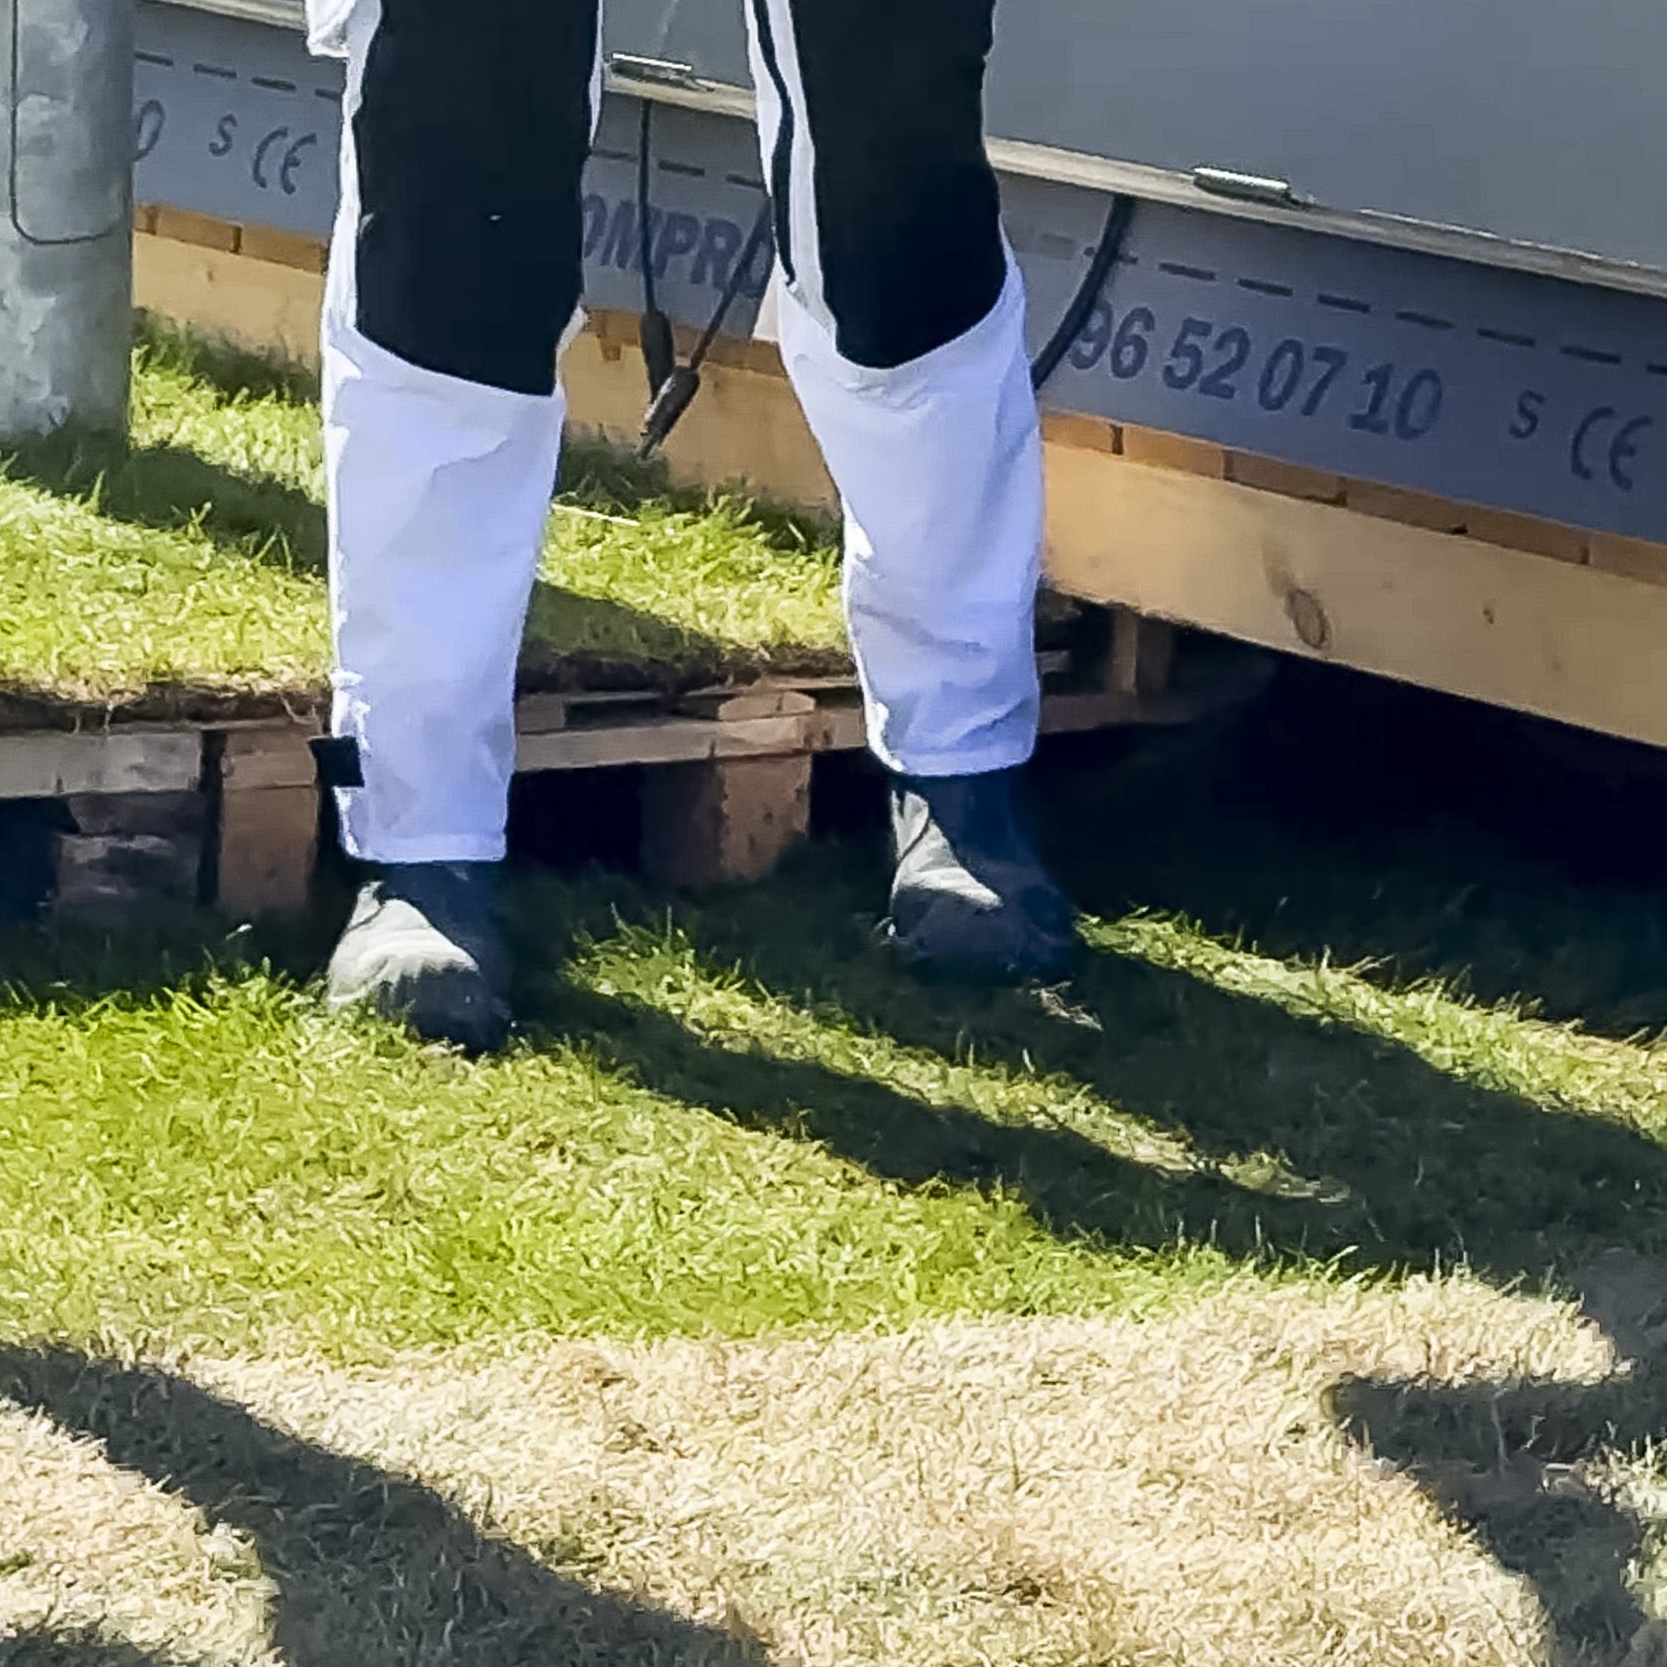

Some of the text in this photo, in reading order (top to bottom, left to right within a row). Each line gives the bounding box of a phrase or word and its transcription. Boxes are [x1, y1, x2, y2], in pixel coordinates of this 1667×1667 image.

[1162, 317, 1252, 400] 52
[1257, 338, 1349, 418] 07
[1346, 363, 1444, 441] 10
